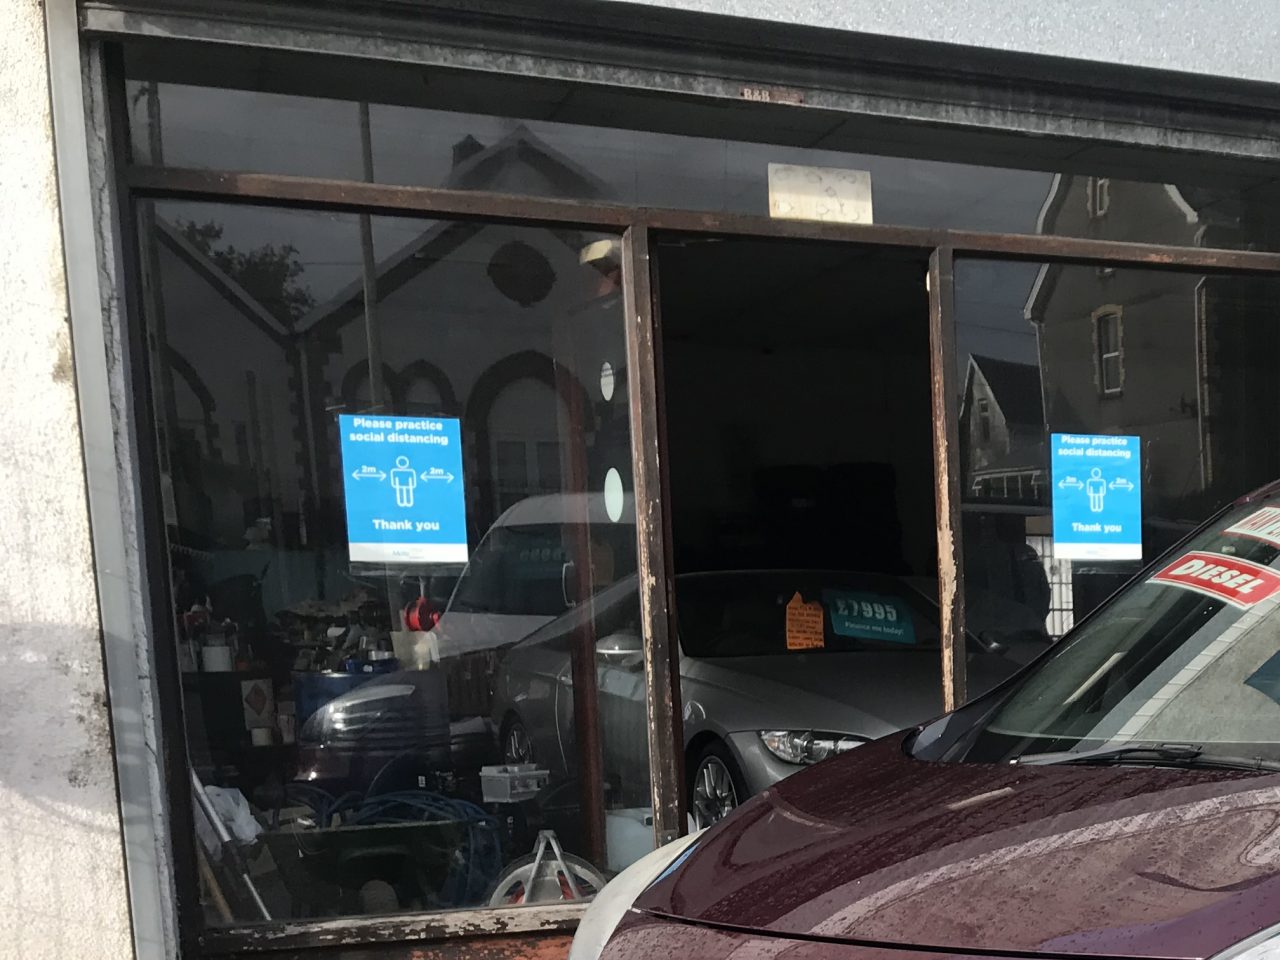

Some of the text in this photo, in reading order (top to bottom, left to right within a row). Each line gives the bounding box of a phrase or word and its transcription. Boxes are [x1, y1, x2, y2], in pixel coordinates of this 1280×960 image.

[743, 88, 771, 102] B&B
[353, 417, 443, 431] Please practice
[349, 432, 449, 446] social distancing
[1061, 435, 1128, 446] Please practice
[1058, 447, 1131, 459] social distancing
[361, 465, 376, 473] 2m
[429, 467, 444, 475] 2m
[372, 518, 440, 532] Thank you
[1071, 521, 1122, 534] Thank you
[1168, 559, 1265, 594] DIESEL
